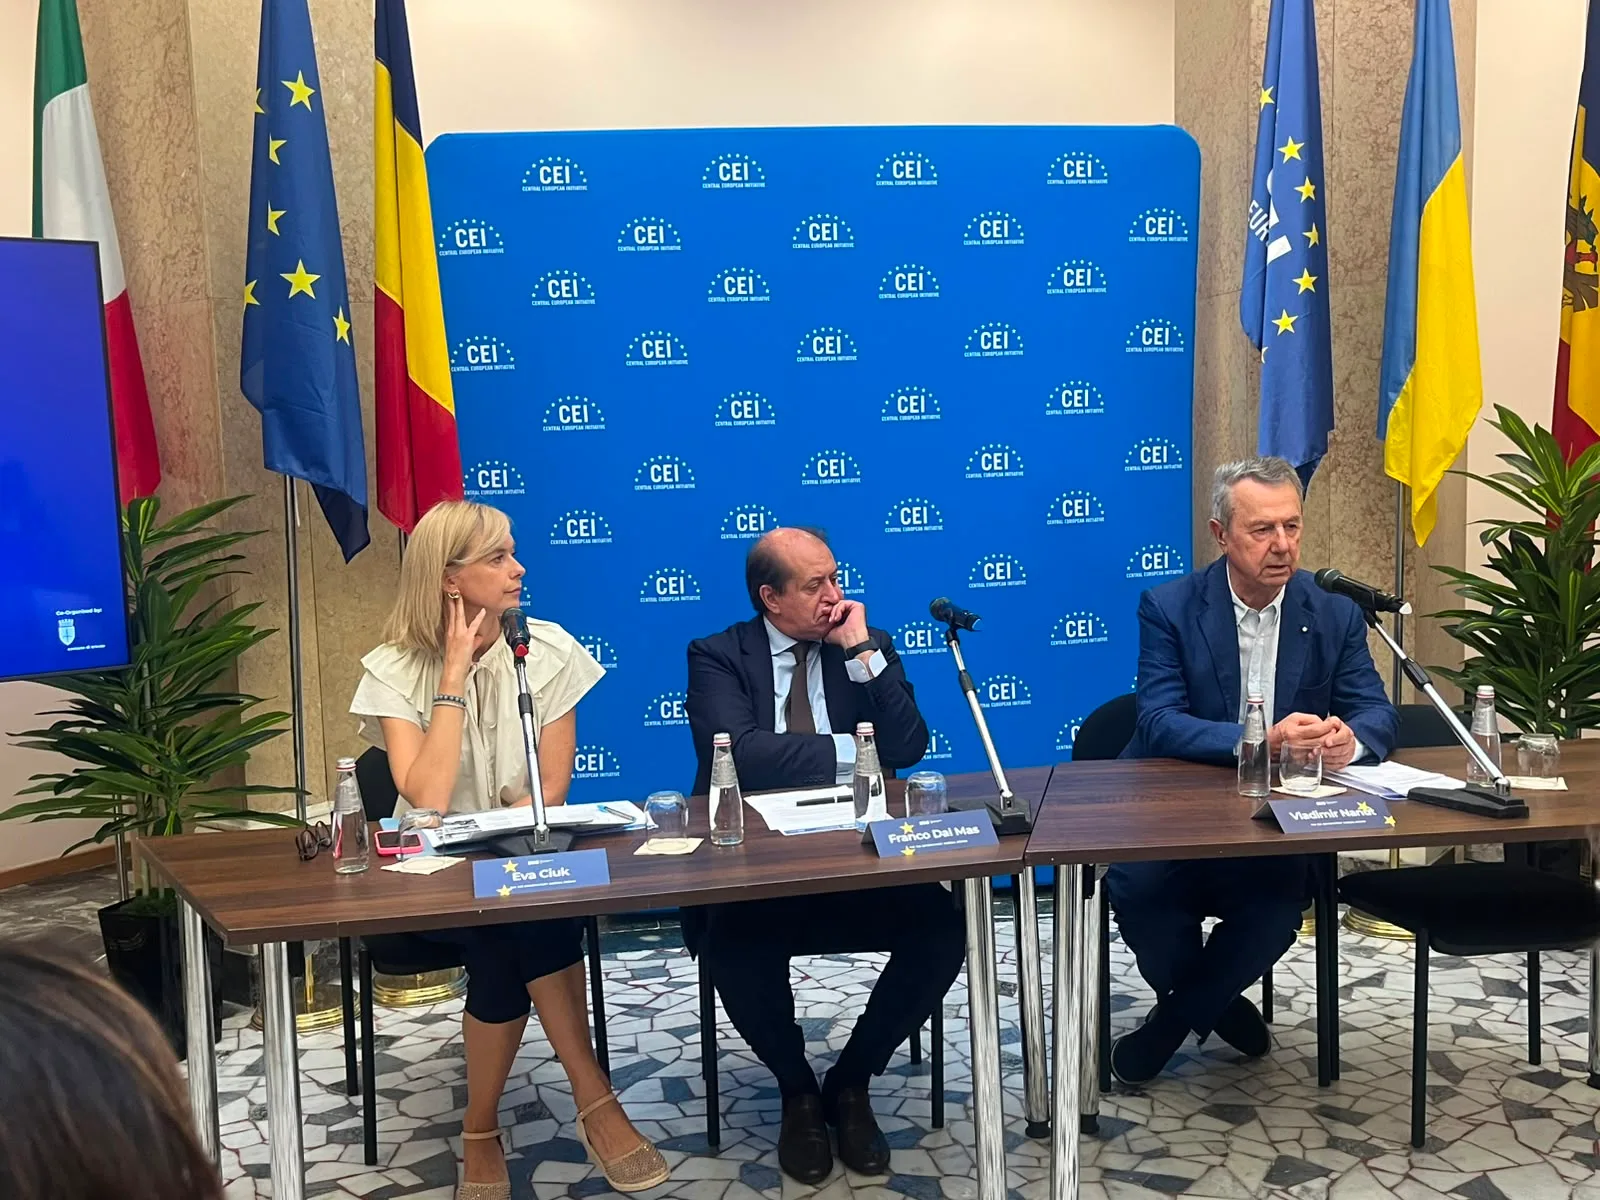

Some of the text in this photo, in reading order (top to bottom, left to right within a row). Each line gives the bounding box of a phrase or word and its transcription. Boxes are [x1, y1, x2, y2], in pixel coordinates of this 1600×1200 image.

[540, 165, 569, 184] CEI
[719, 162, 748, 181] CEI
[892, 160, 921, 179] CEI
[1063, 160, 1092, 178] CEI
[809, 222, 837, 241] CEI
[980, 220, 1008, 238] CEI
[1145, 216, 1173, 235] CEI
[1248, 200, 1270, 246] EUR
[455, 228, 486, 248] CEI
[634, 225, 664, 244] CEI
[724, 276, 753, 295] CEI
[895, 272, 923, 291] CEI
[1063, 268, 1091, 286] CEI
[548, 279, 578, 298] CEI
[813, 336, 841, 354] CEI
[980, 331, 1008, 349] CEI
[1141, 327, 1169, 345] CEI
[467, 344, 498, 364] CEI
[642, 339, 671, 358] CEI
[897, 395, 925, 414] CEI
[1061, 389, 1089, 407] CEI
[559, 404, 588, 423] CEI
[731, 400, 759, 419] CEI
[981, 452, 1008, 471] CEI
[1140, 445, 1167, 464] CEI
[650, 464, 679, 483] CEI
[817, 458, 845, 477] CEI
[478, 469, 507, 489] CEI
[900, 506, 927, 525] CEI
[1062, 498, 1089, 517] CEI
[567, 518, 595, 537] CEI
[737, 513, 764, 532] CEI
[1141, 551, 1168, 570] CEI
[984, 561, 1011, 580] CEI
[656, 576, 684, 595] CEI
[1066, 619, 1092, 638] CEI
[905, 629, 931, 648] CEI
[989, 682, 1016, 701] CEI
[575, 753, 603, 772] CEI
[1288, 809, 1338, 820] Vladimir
[888, 826, 980, 843] Franco Dal Mas
[512, 867, 570, 881] Eva Ciuk
